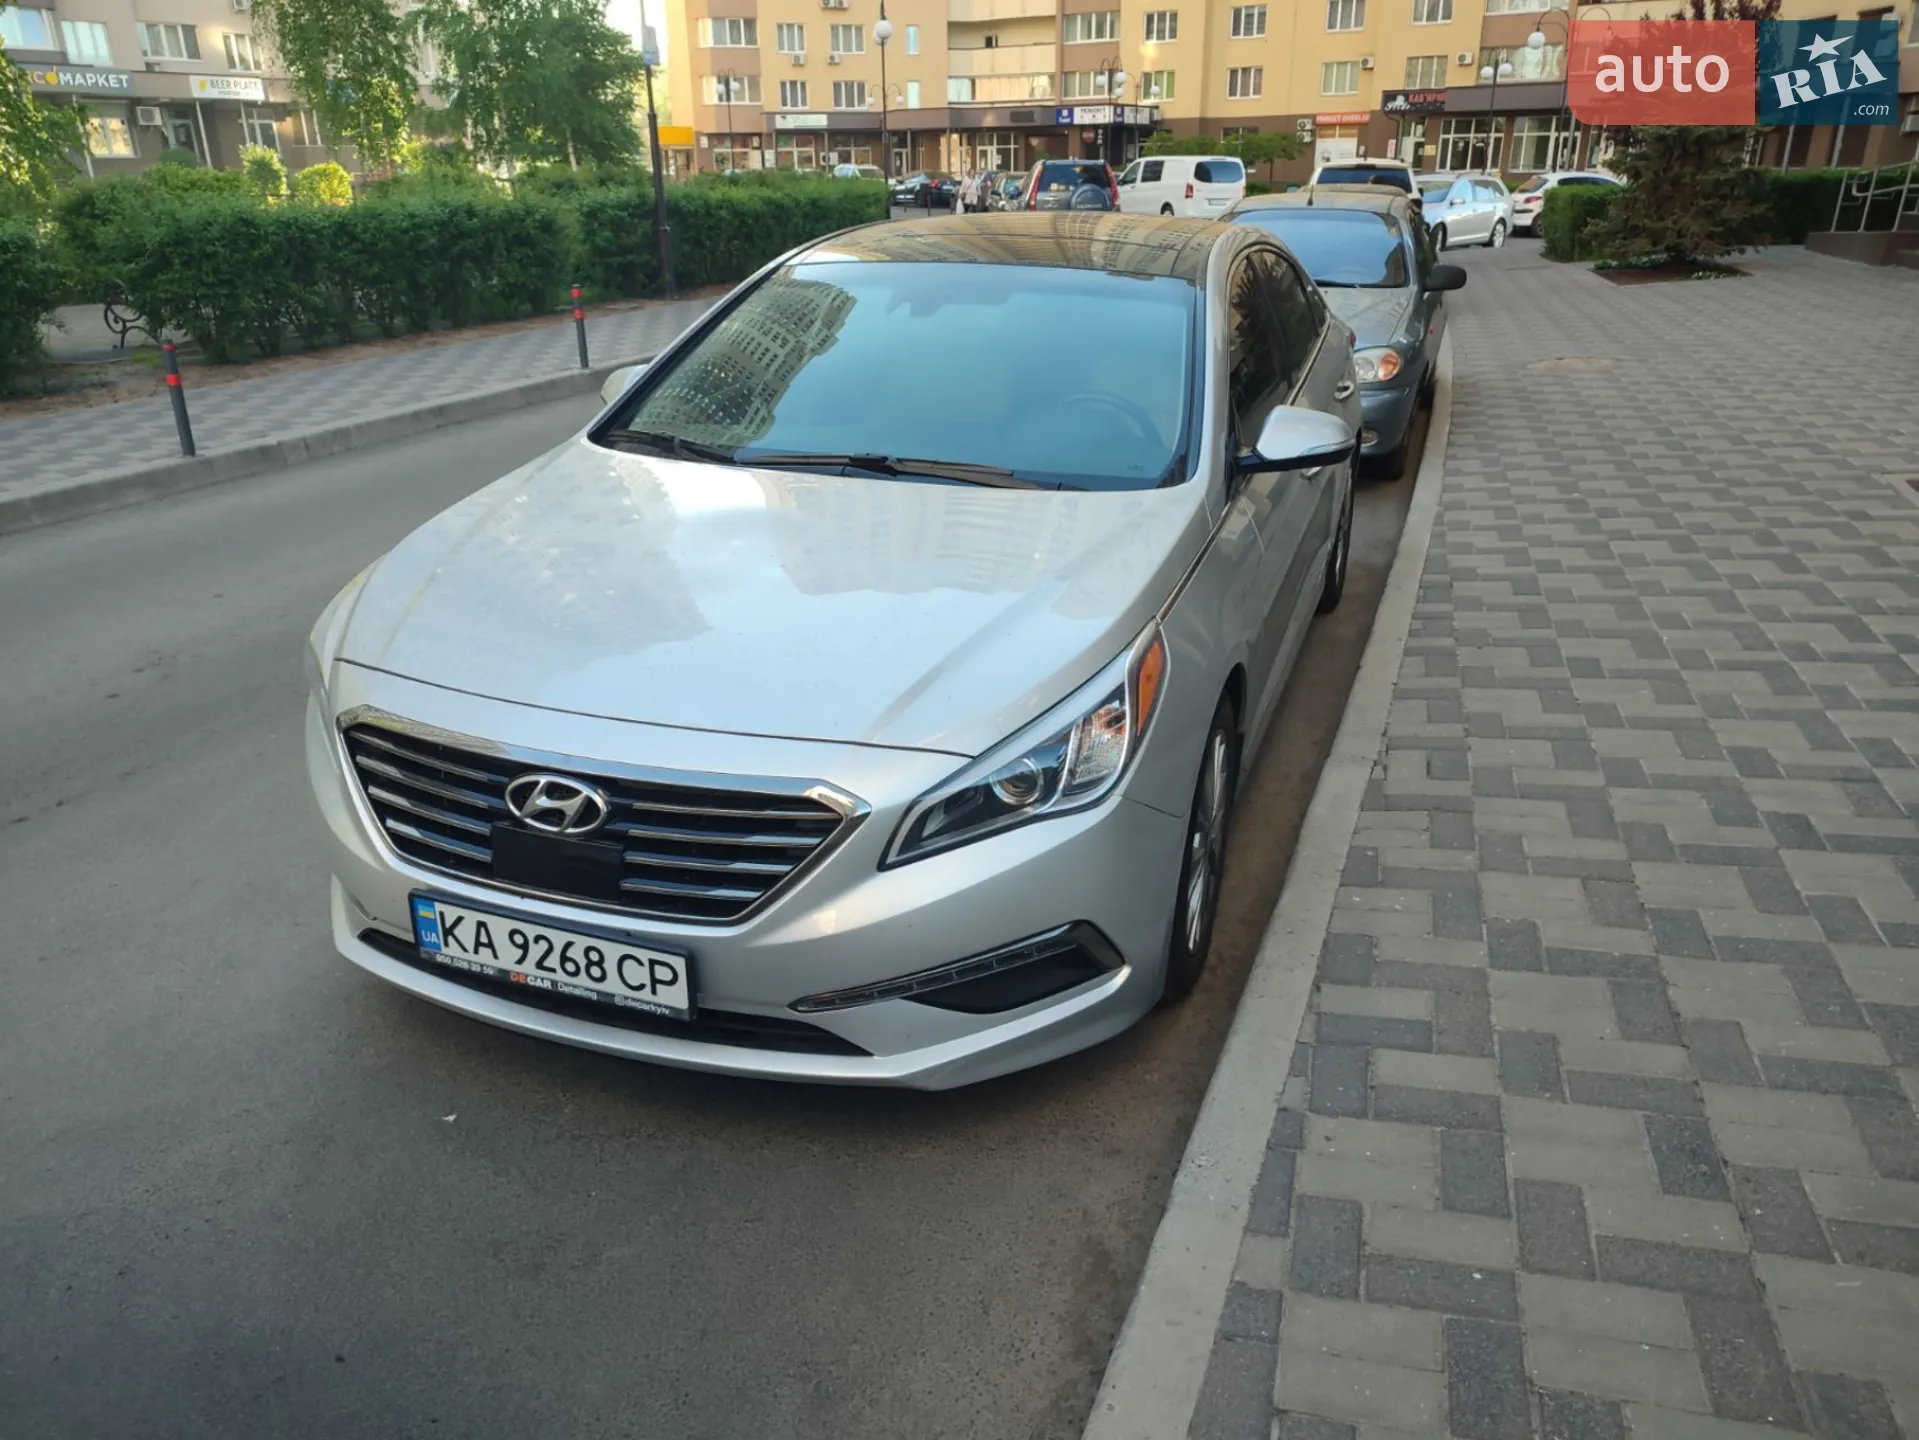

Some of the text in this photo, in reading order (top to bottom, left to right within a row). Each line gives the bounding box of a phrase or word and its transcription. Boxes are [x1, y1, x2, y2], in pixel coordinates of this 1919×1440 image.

[210, 79, 232, 89] BEER
[421, 930, 439, 944] UA
[439, 910, 679, 996] KA 9268 CP
[510, 971, 597, 1000] DECAR Detailing
